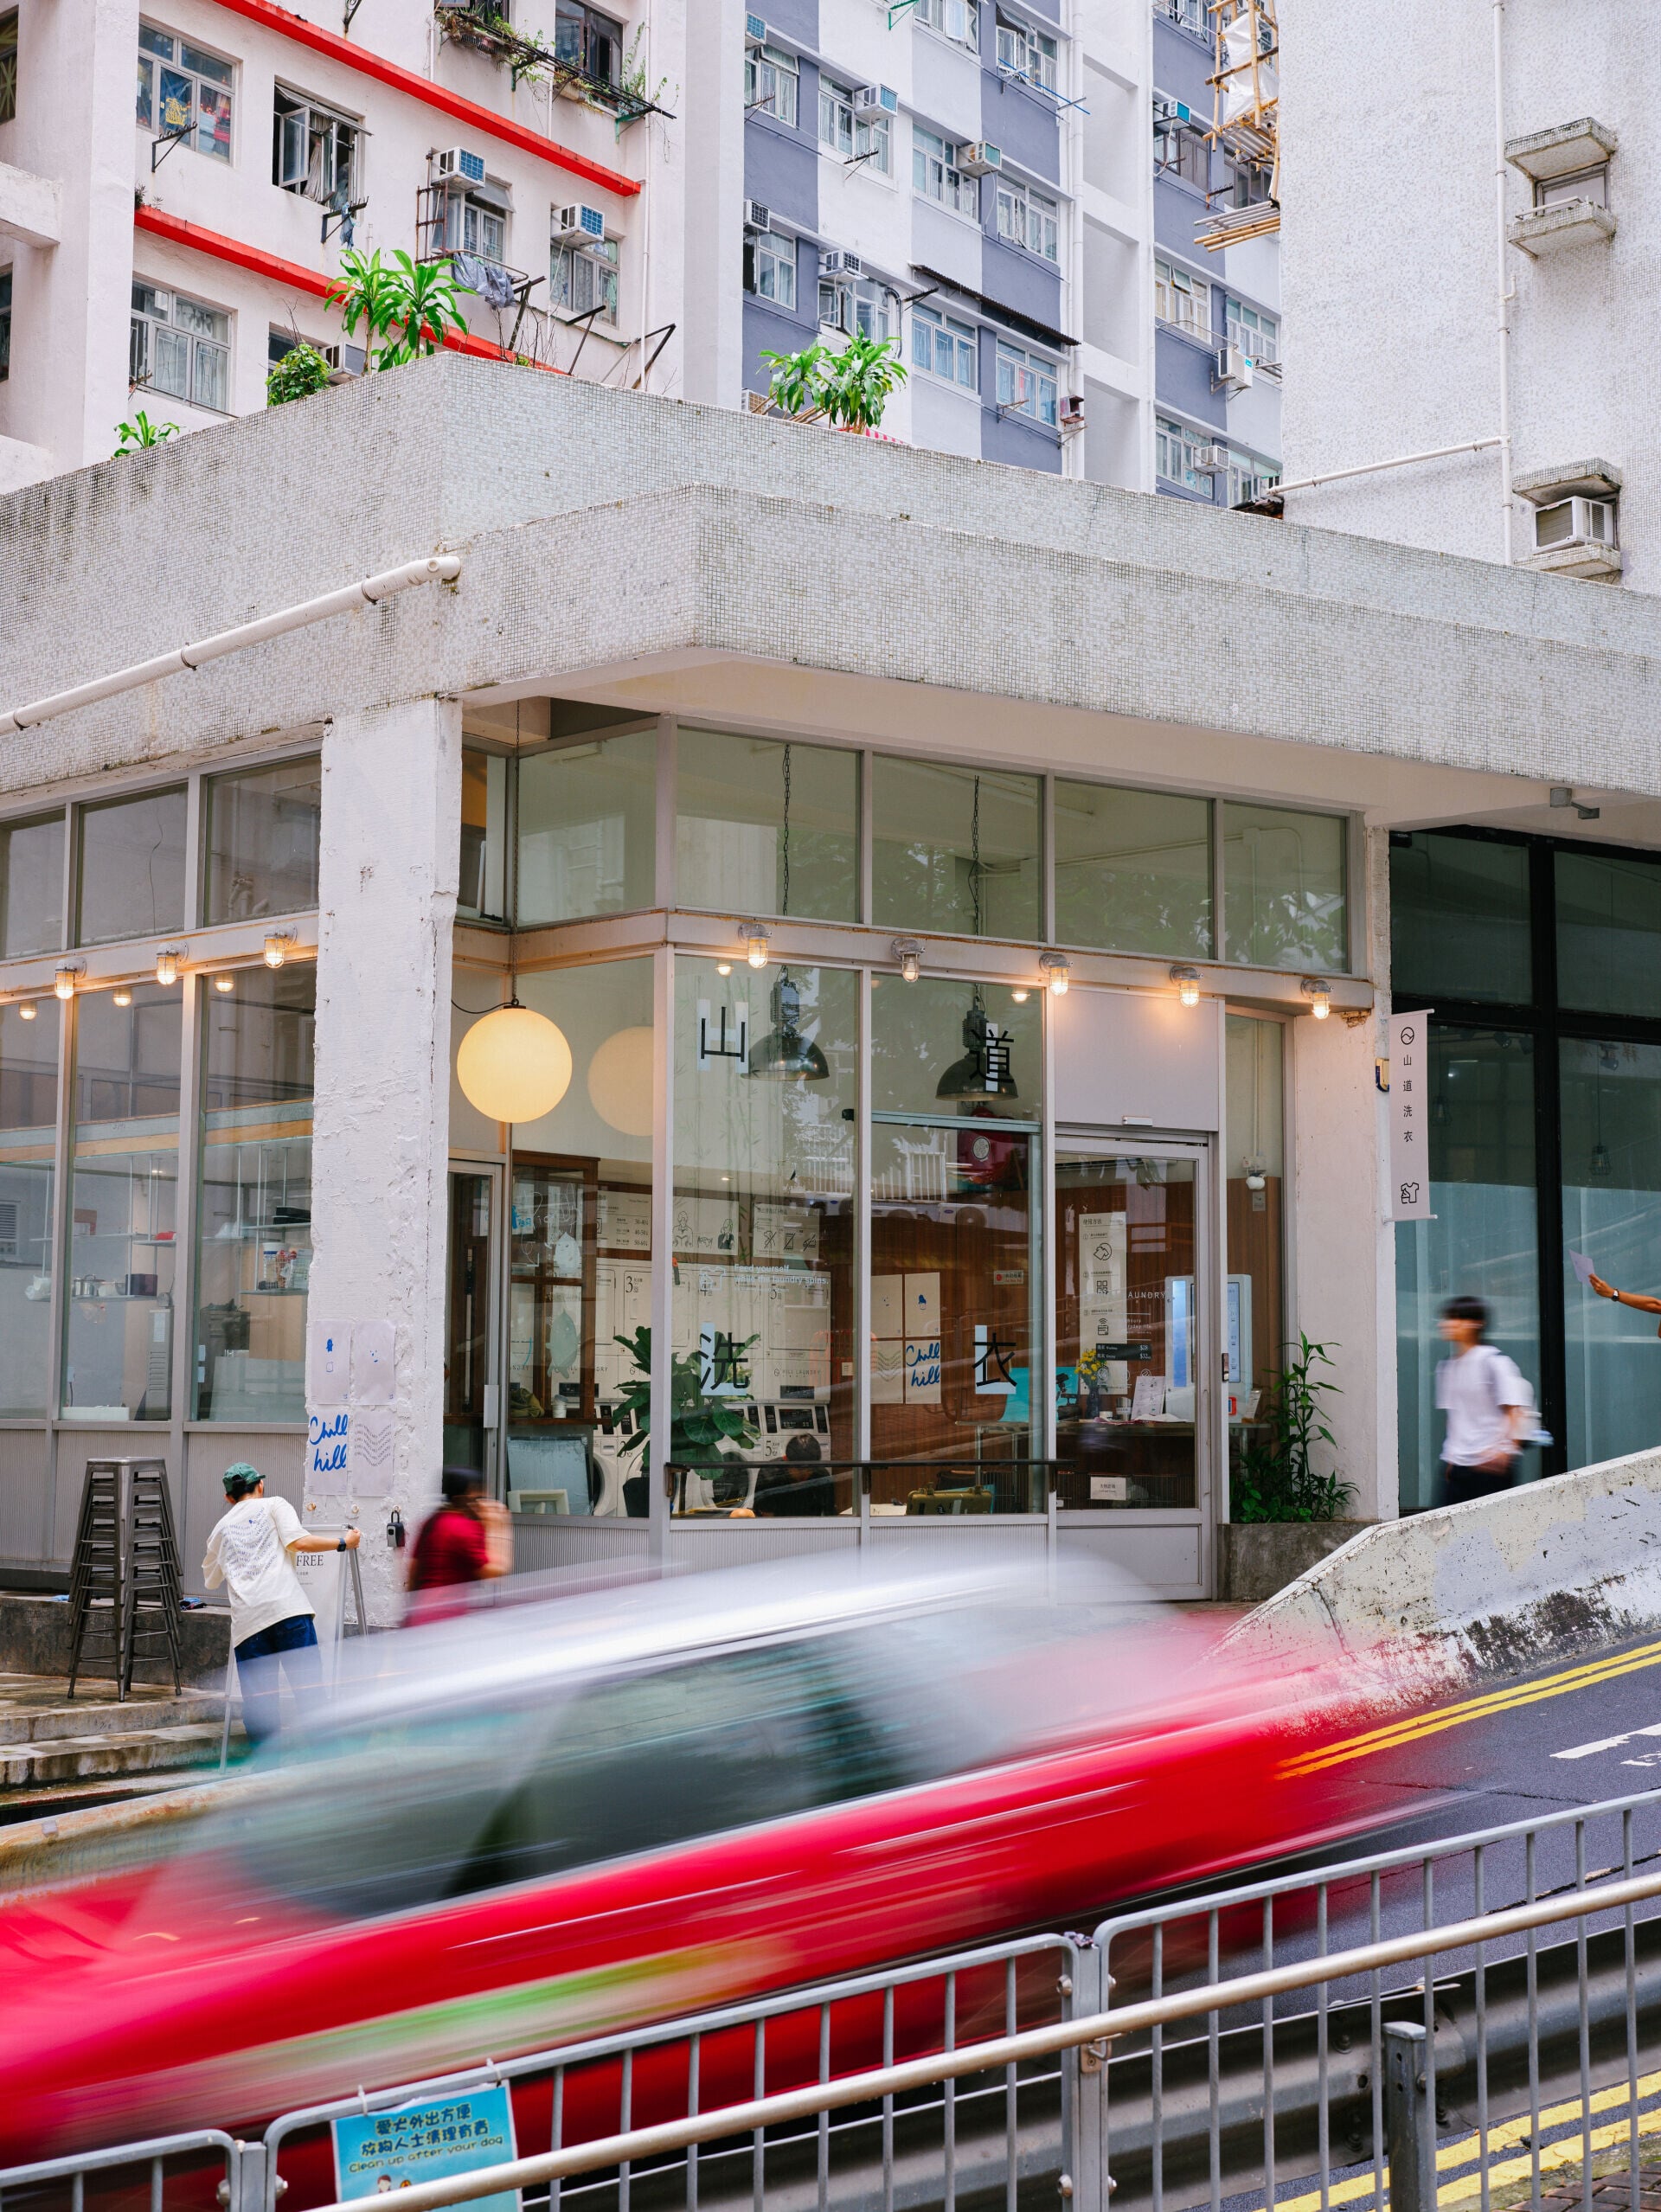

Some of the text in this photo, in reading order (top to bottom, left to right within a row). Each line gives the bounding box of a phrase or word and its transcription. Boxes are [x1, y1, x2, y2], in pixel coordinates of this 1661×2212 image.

[701, 1006, 1014, 1083] 山 道
[1402, 1055, 1413, 1143] 山道洗衣
[756, 1265, 790, 1273] yourself
[773, 1275, 803, 1285] laundry
[625, 1276, 633, 1293] 3
[698, 1332, 1017, 1390] 洗 衣
[907, 1343, 940, 1367] Chill
[911, 1365, 940, 1387] hill
[310, 1414, 348, 1445] Chill
[313, 1444, 347, 1471] hill
[766, 1440, 773, 1457] 5
[296, 1555, 324, 1567] FREE
[375, 2103, 471, 2136] 愛犬外出方便
[362, 2119, 489, 2157] 放狗人士清理有責
[349, 2135, 503, 2173] Clean up after your dog
